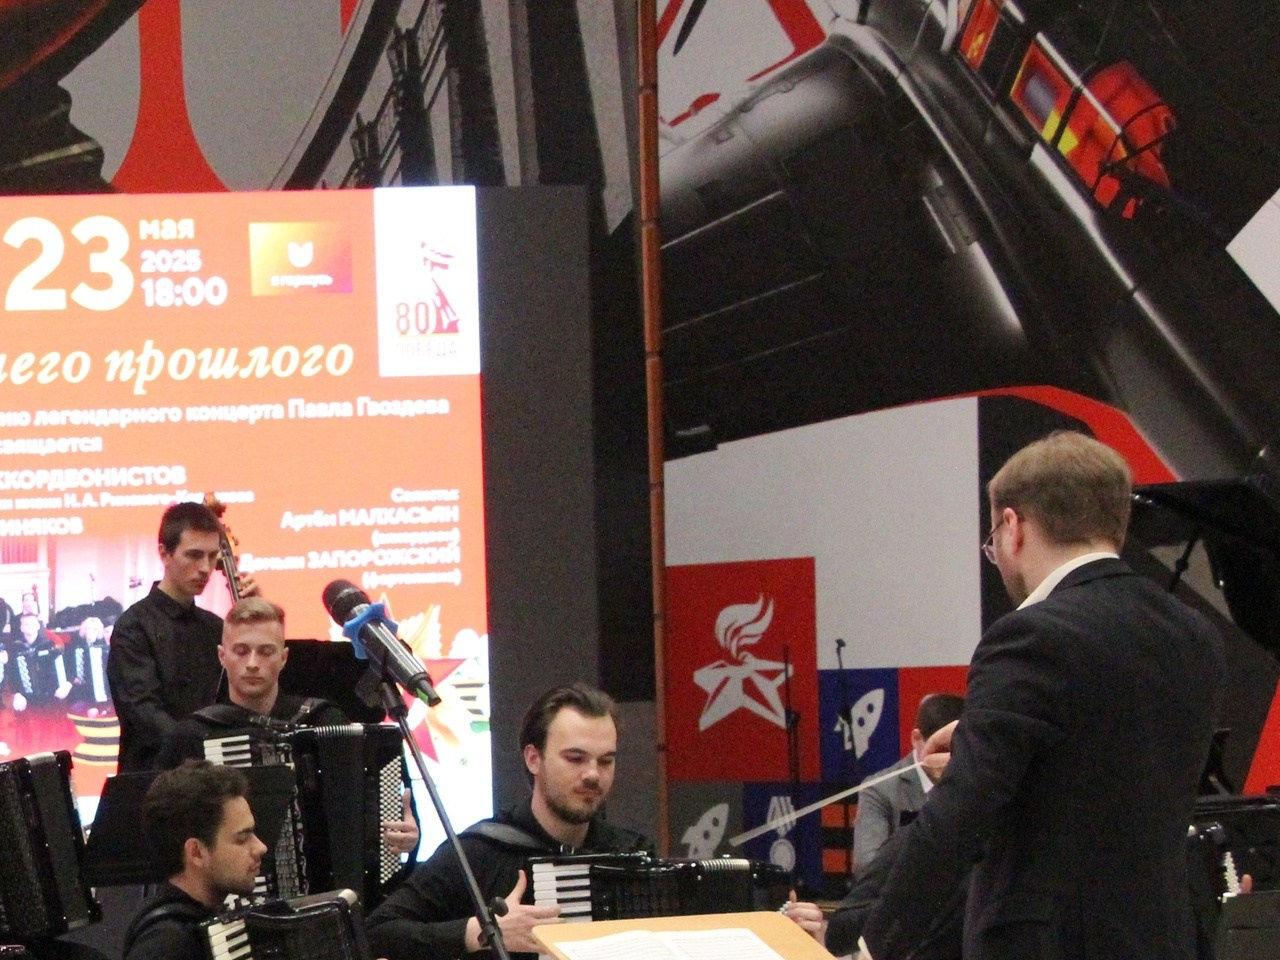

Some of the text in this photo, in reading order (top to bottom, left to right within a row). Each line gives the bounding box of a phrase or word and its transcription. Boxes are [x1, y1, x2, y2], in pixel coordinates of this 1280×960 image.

[2, 215, 134, 311] 23
[140, 248, 203, 273] 2025
[140, 275, 228, 308] 18:00
[396, 301, 429, 335] 80
[105, 340, 354, 395] прошлого
[34, 406, 183, 428] легендарного
[186, 403, 285, 425] концерта
[288, 398, 354, 419] Павла
[356, 396, 450, 417] Гвоздева
[306, 542, 461, 569] ЗАПОРОЖСКИЙ
